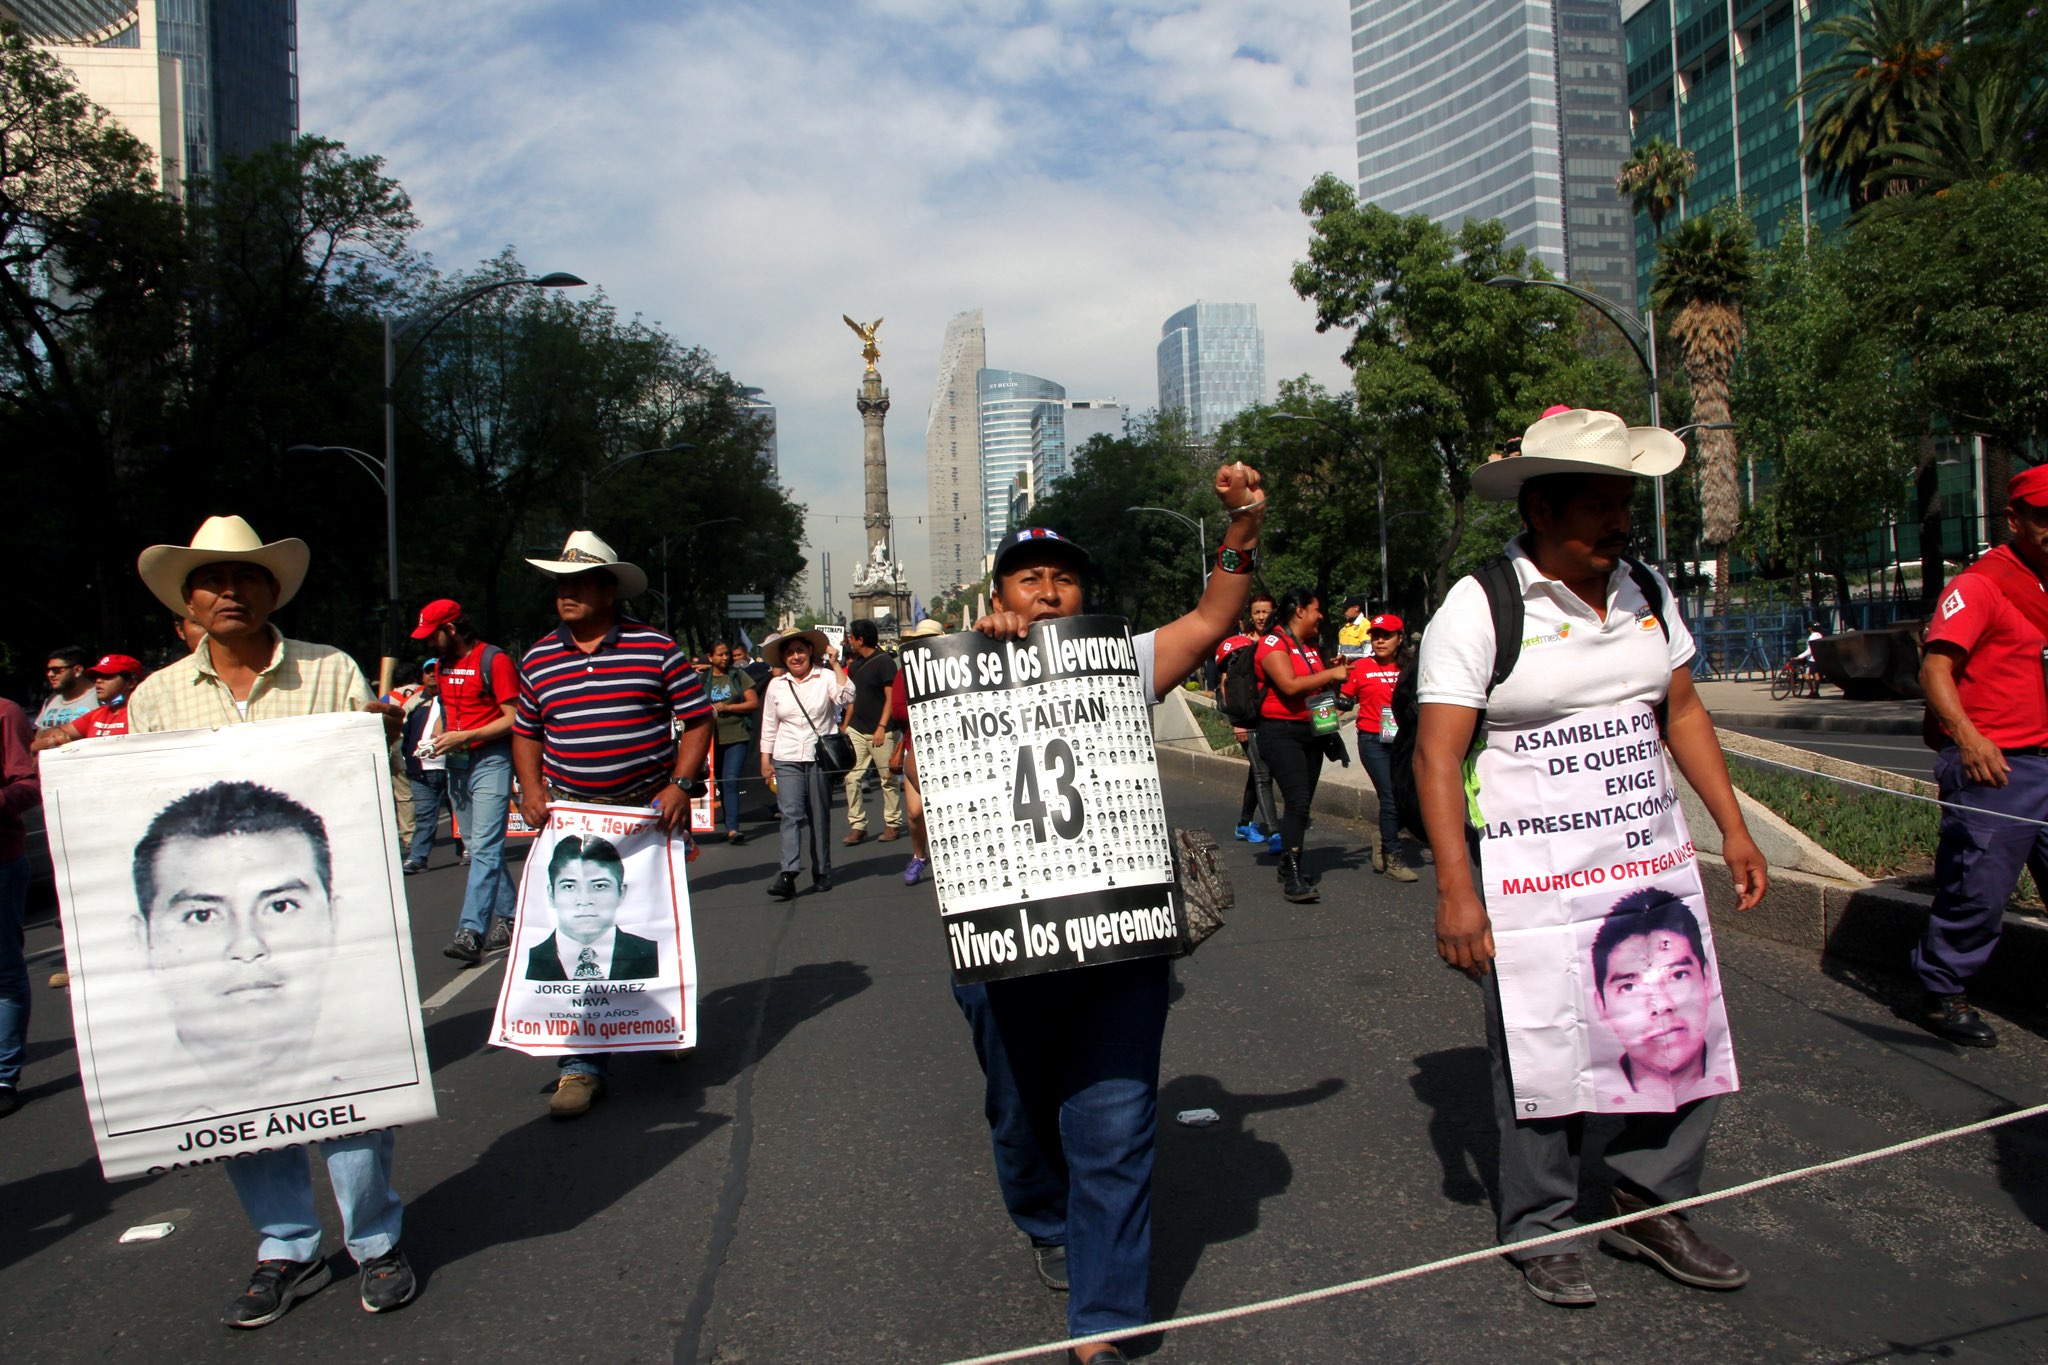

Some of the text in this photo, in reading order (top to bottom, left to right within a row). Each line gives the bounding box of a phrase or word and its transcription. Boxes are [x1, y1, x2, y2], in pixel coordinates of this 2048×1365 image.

[903, 624, 1136, 699] ¡Vivos se los llevaron!
[960, 696, 1107, 741] NOS FALTAN
[1513, 718, 1628, 753] ASAMBLEA
[1548, 756, 1579, 776] DE
[1605, 769, 1657, 797] EXIGE
[1012, 738, 1086, 845] 43
[1486, 819, 1513, 841] LA
[1517, 793, 1664, 837] PRESENTACIÓN
[1626, 829, 1654, 851] DE:
[1502, 865, 1606, 896] MAURICIO
[1609, 851, 1676, 881] ORTEGA
[948, 892, 1178, 971] ¡Vivos los queremos!
[535, 982, 647, 995] JORGE ÁLVAREZ
[572, 997, 610, 1008] NAVA
[511, 1016, 676, 1040] ¡Con VIDA lo queremos!
[586, 1011, 600, 1019] 19
[604, 1008, 640, 1018] AÑOS
[177, 1120, 258, 1152] JOSE
[265, 1103, 367, 1137] ÁNGEL
